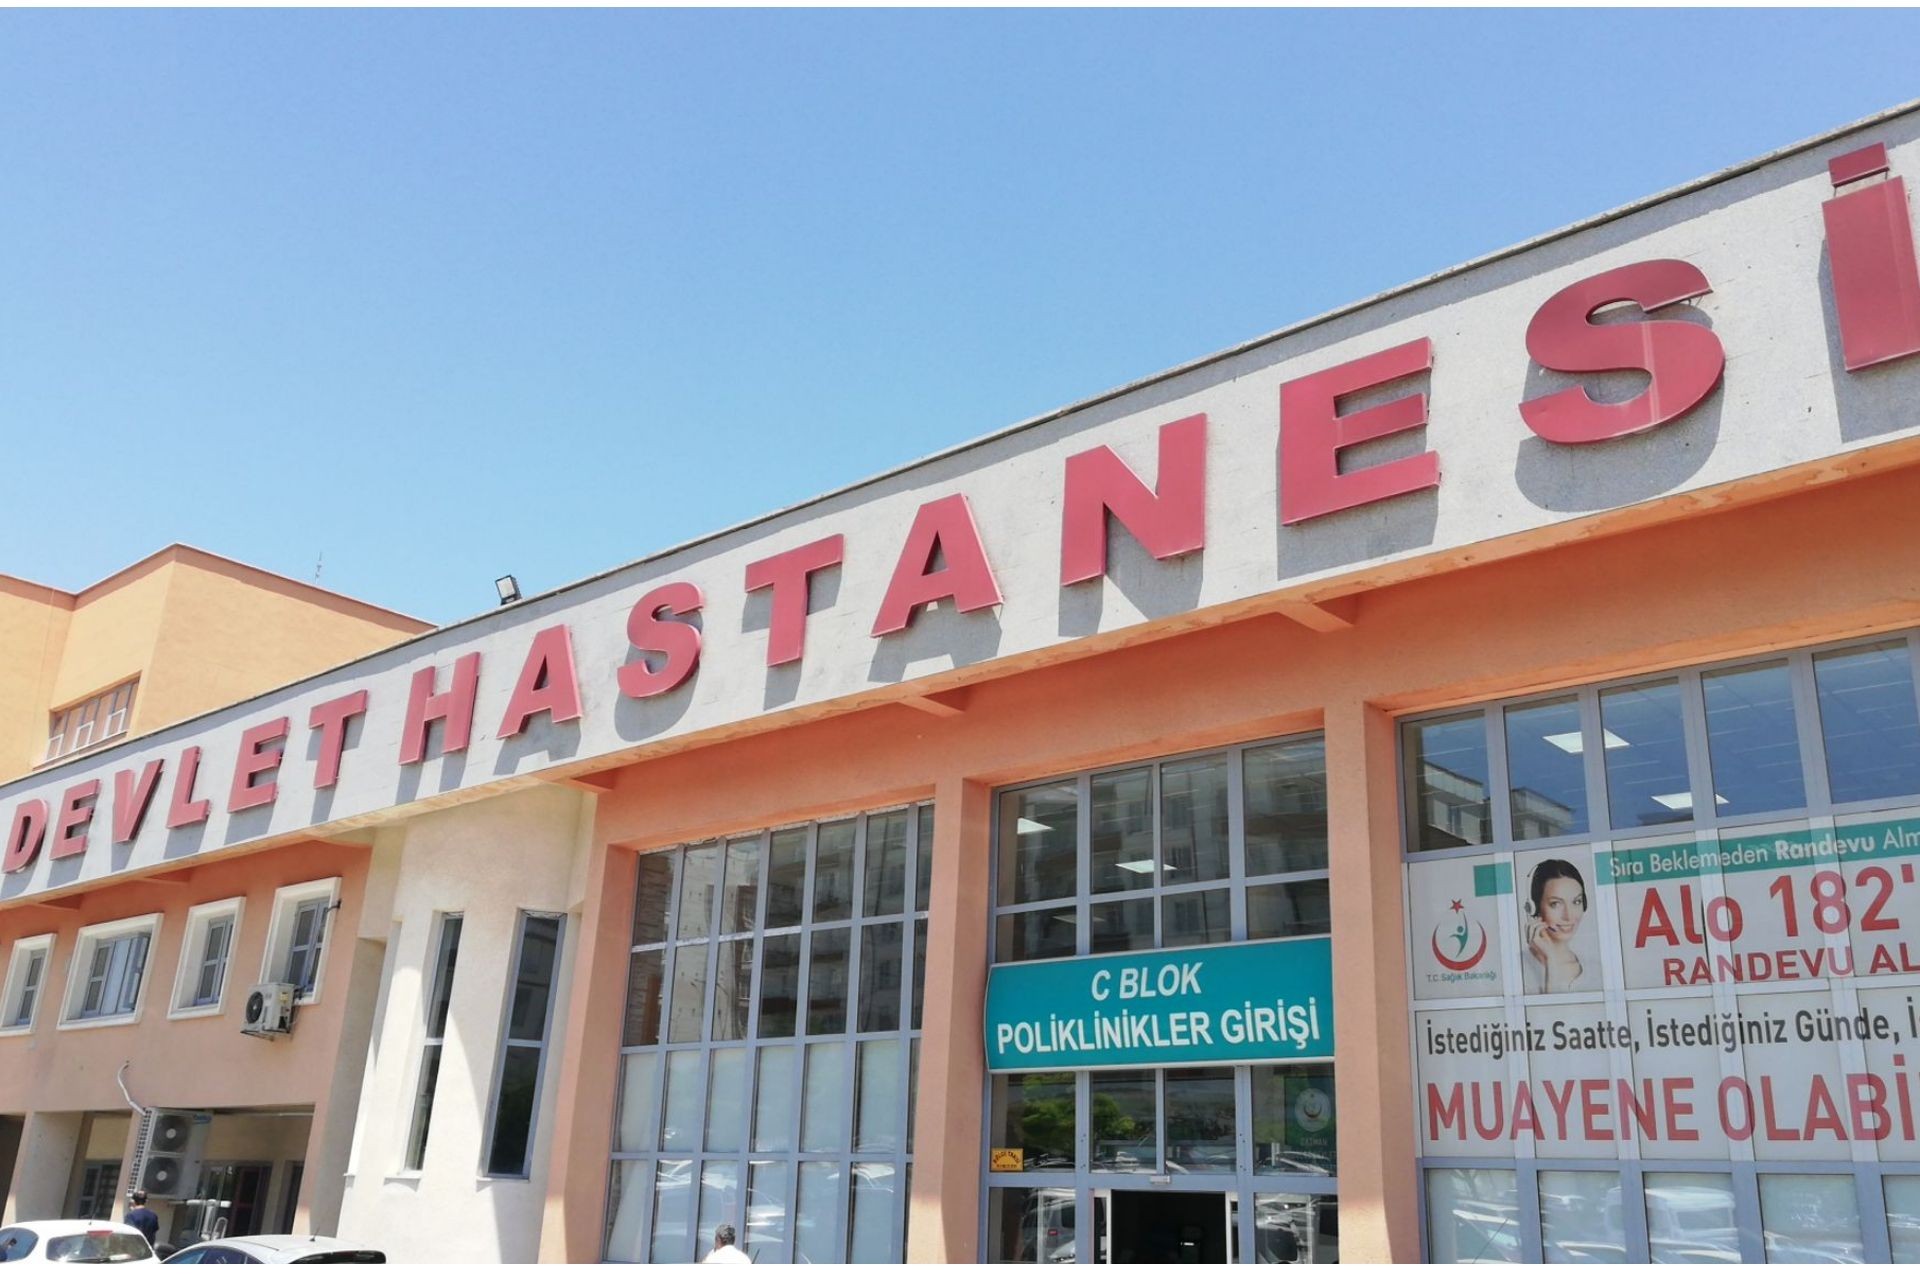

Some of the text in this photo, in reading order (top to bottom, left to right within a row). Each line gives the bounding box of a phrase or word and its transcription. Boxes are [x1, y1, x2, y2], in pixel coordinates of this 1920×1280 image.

[2, 142, 1920, 874] DEVLET HASTANESİ
[1610, 857, 1645, 877] Sıra
[1651, 845, 1768, 872] Beklemeden
[1775, 837, 1875, 861] Randevu
[1635, 884, 1743, 948] Alo
[1092, 962, 1203, 1001] C BLOK
[1663, 946, 1851, 986] RANDEVU
[997, 997, 1320, 1055] POLİKLİNİKLER GİRİŞİ
[1427, 1019, 1546, 1060] İstediğiniz
[1553, 1020, 1640, 1054] Saatte,
[1647, 1009, 1787, 1053] İstediğiniz
[1795, 1007, 1900, 1045] Günde,
[1427, 1054, 1920, 1141] MUAYENE OLABİ
